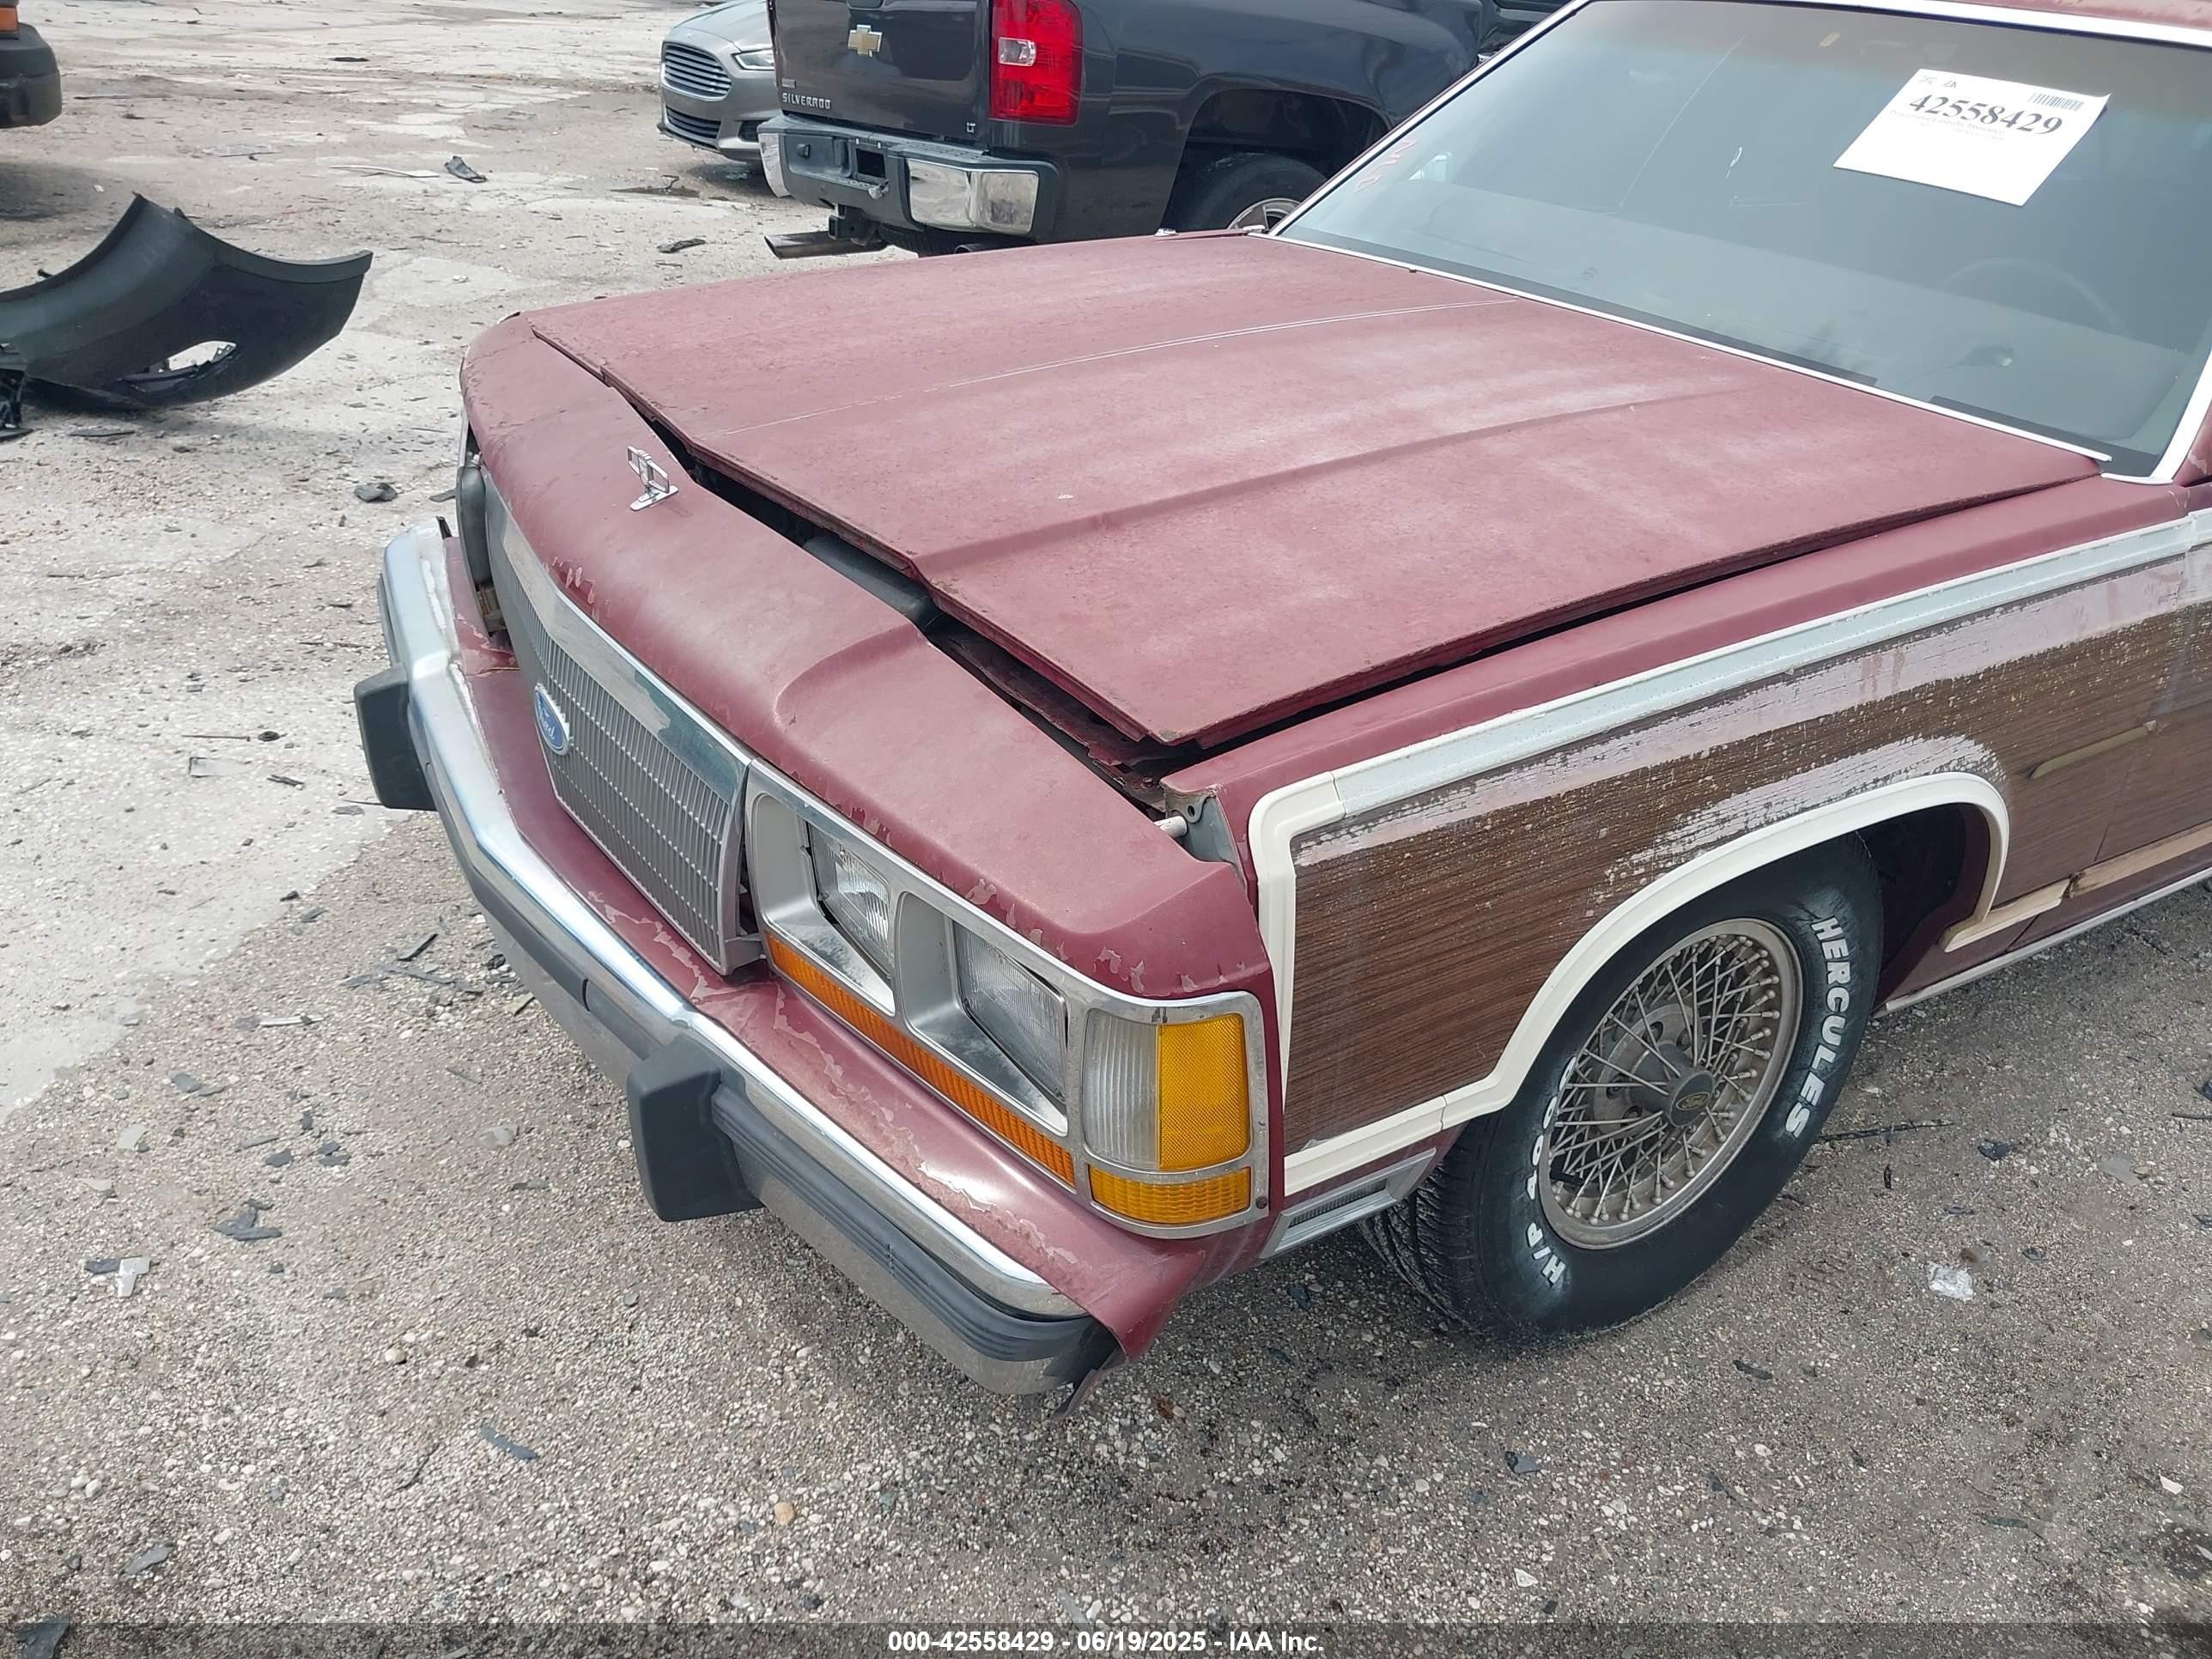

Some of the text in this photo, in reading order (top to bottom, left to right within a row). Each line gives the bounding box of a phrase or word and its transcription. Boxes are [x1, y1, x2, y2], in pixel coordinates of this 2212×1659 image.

[782, 92, 830, 110] SILVERADO
[1909, 94, 2063, 135] 42558429
[1785, 915, 1850, 1139] HERCULES
